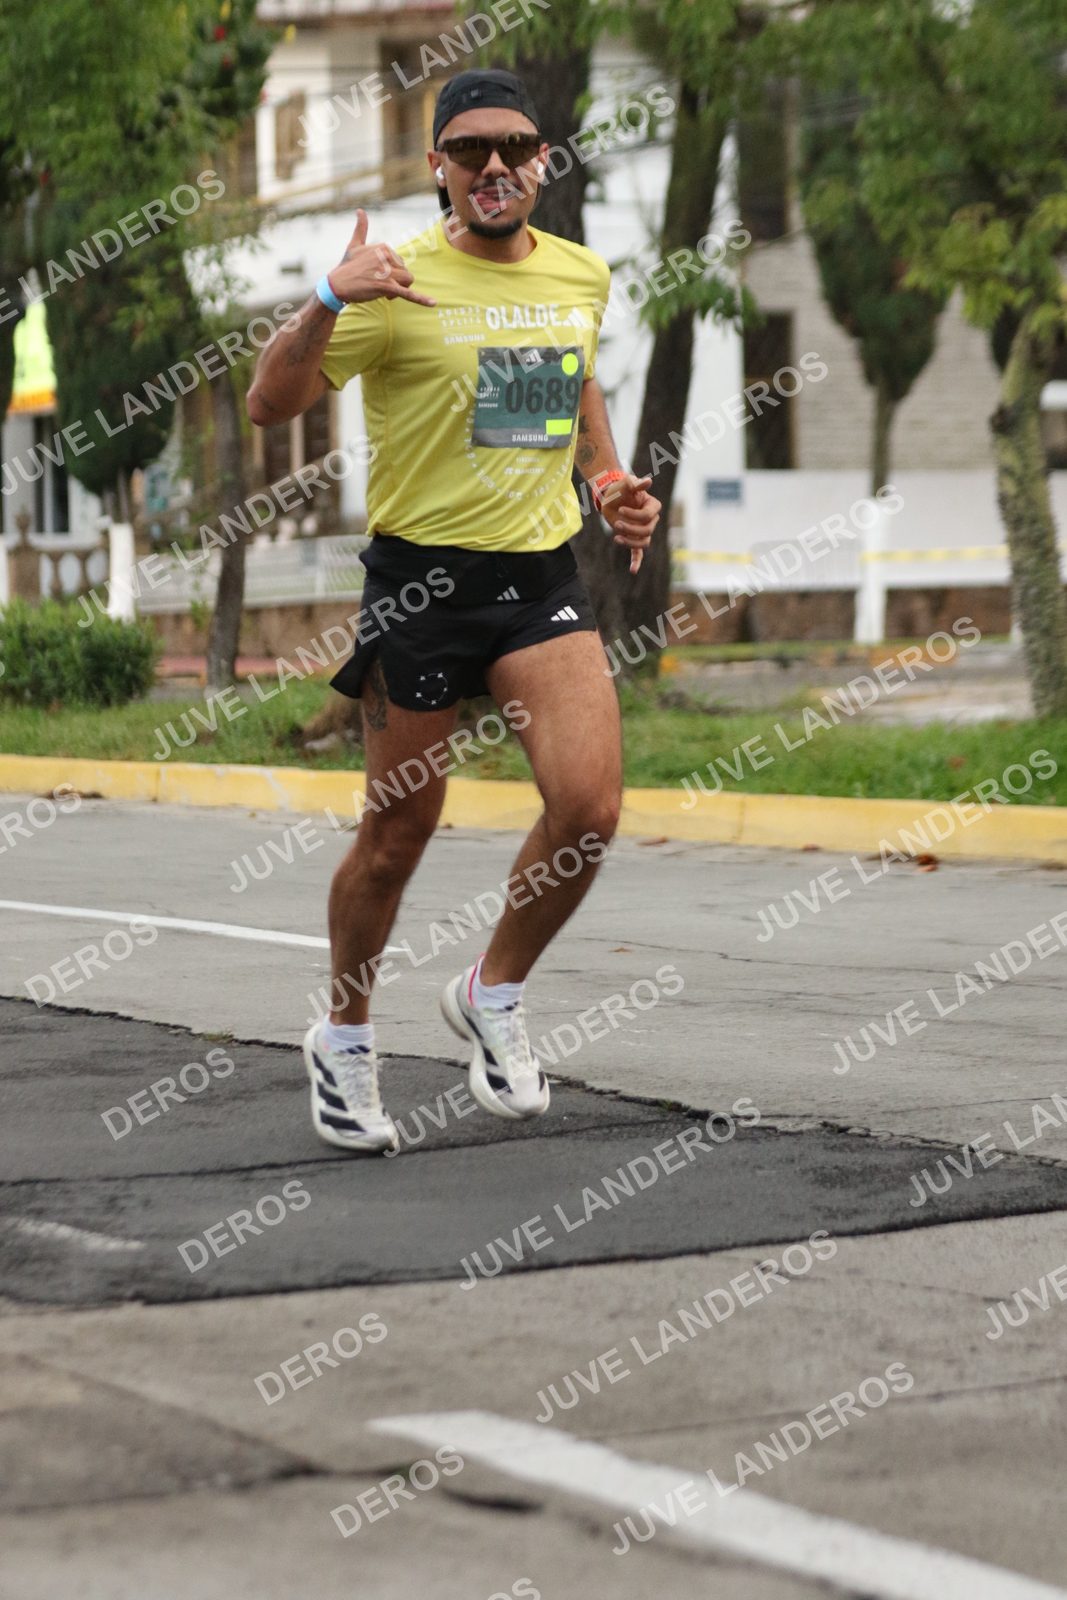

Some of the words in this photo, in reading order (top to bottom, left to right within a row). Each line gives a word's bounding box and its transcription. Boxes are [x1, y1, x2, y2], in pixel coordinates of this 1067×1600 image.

[485, 304, 562, 330] OLALDE
[504, 377, 580, 414] 0689
[512, 434, 549, 442] SAMSUNG
